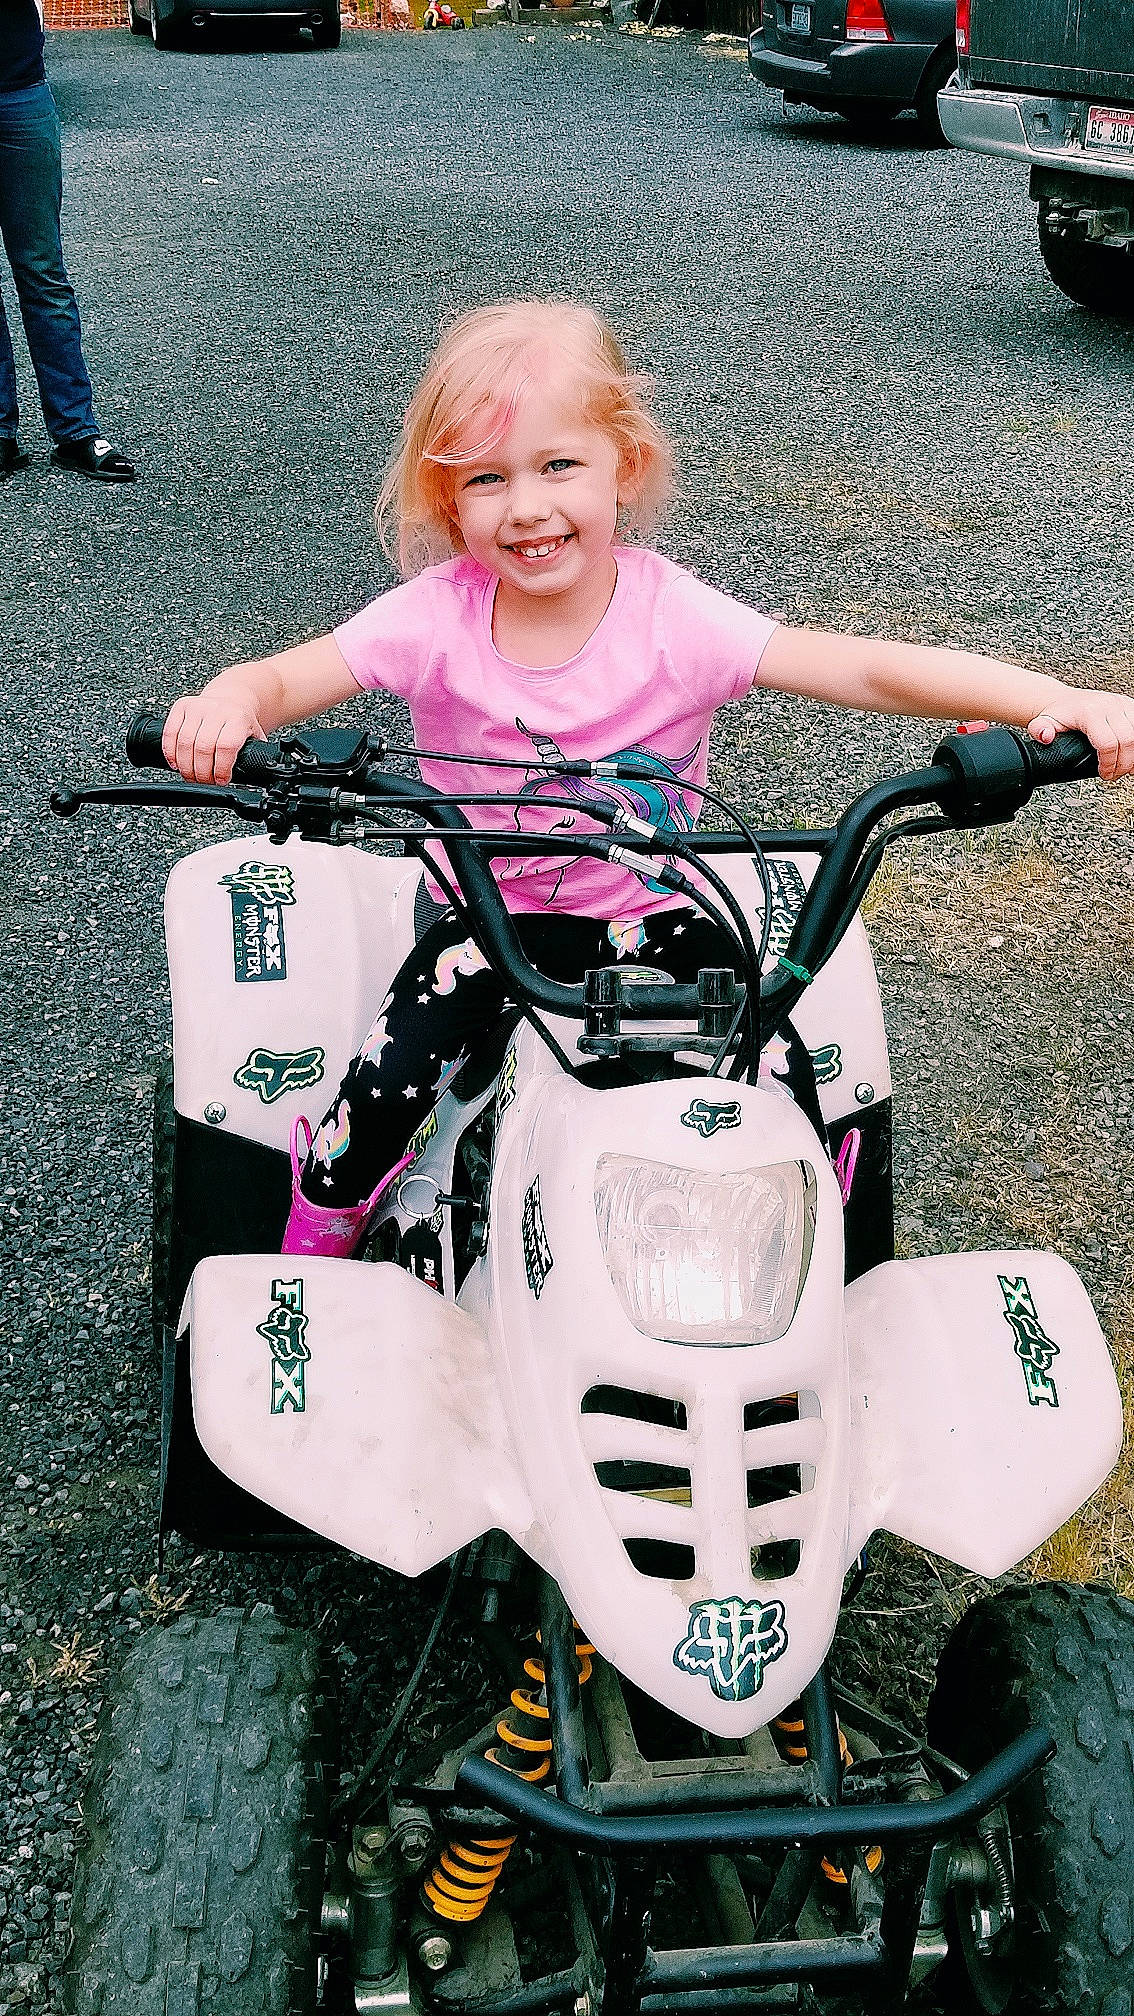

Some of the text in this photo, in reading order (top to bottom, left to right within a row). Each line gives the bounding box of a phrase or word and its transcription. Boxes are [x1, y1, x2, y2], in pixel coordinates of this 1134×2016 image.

[234, 915, 244, 968] ENERGY
[241, 903, 263, 979] MONSTER
[255, 1278, 311, 1414] FOX
[996, 1274, 1061, 1408] FOX
